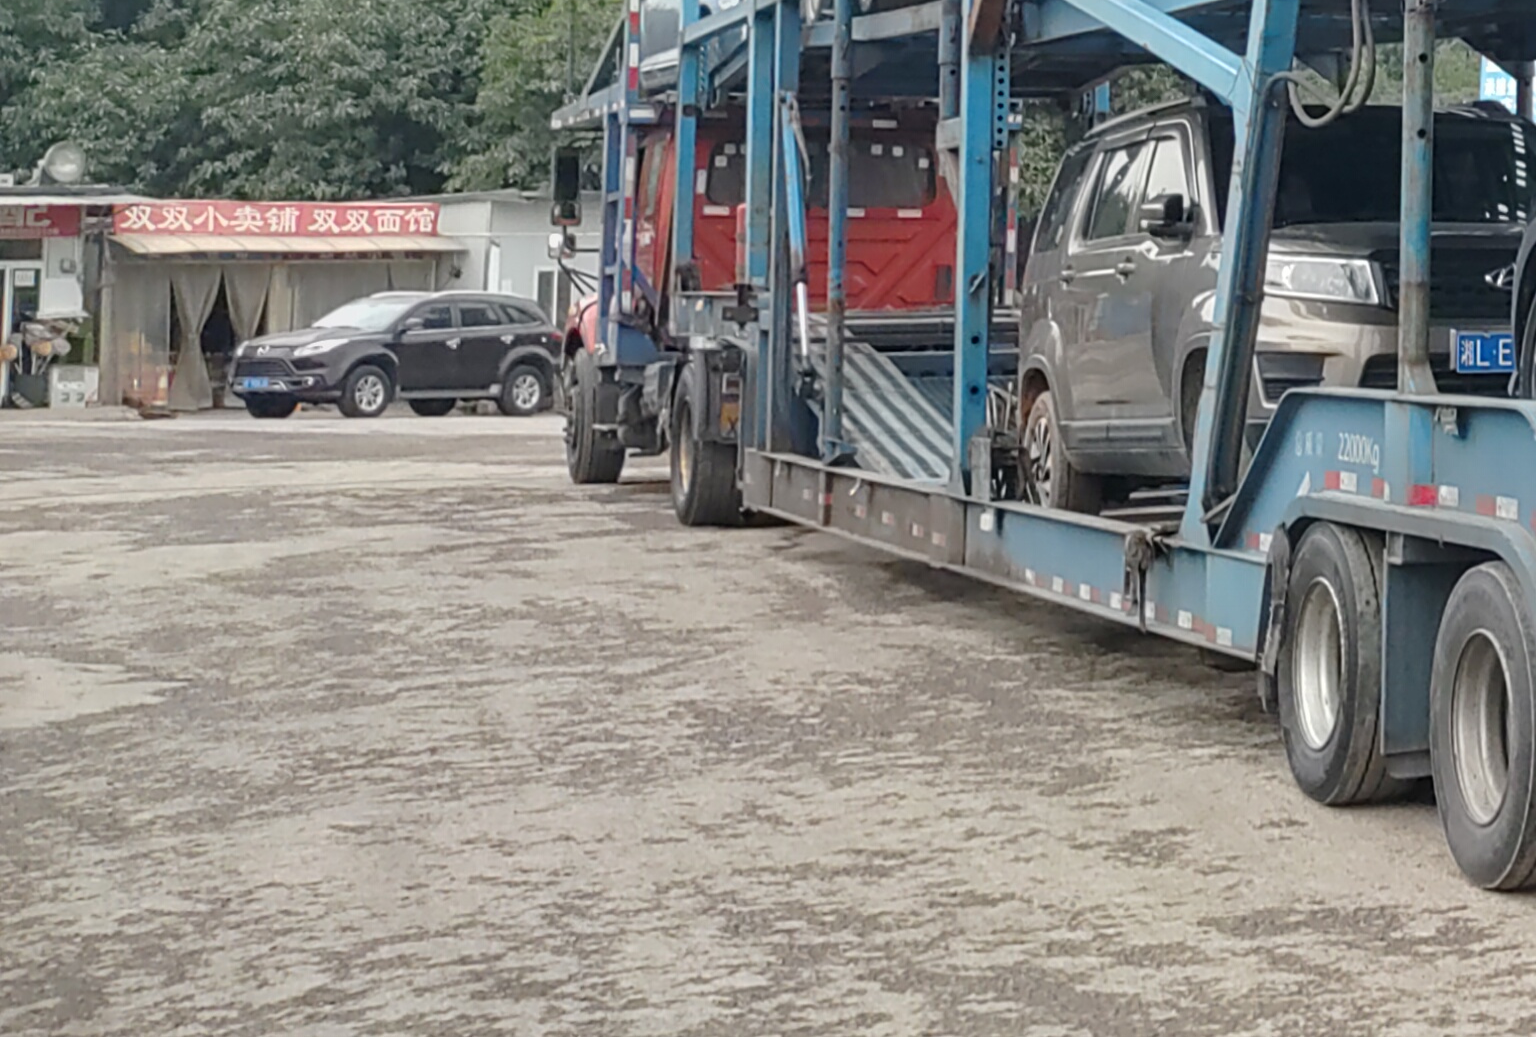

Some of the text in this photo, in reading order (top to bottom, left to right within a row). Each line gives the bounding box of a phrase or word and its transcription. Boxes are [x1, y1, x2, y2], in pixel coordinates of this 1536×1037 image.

[121, 204, 434, 234] 双双小卖铺 双双面馆
